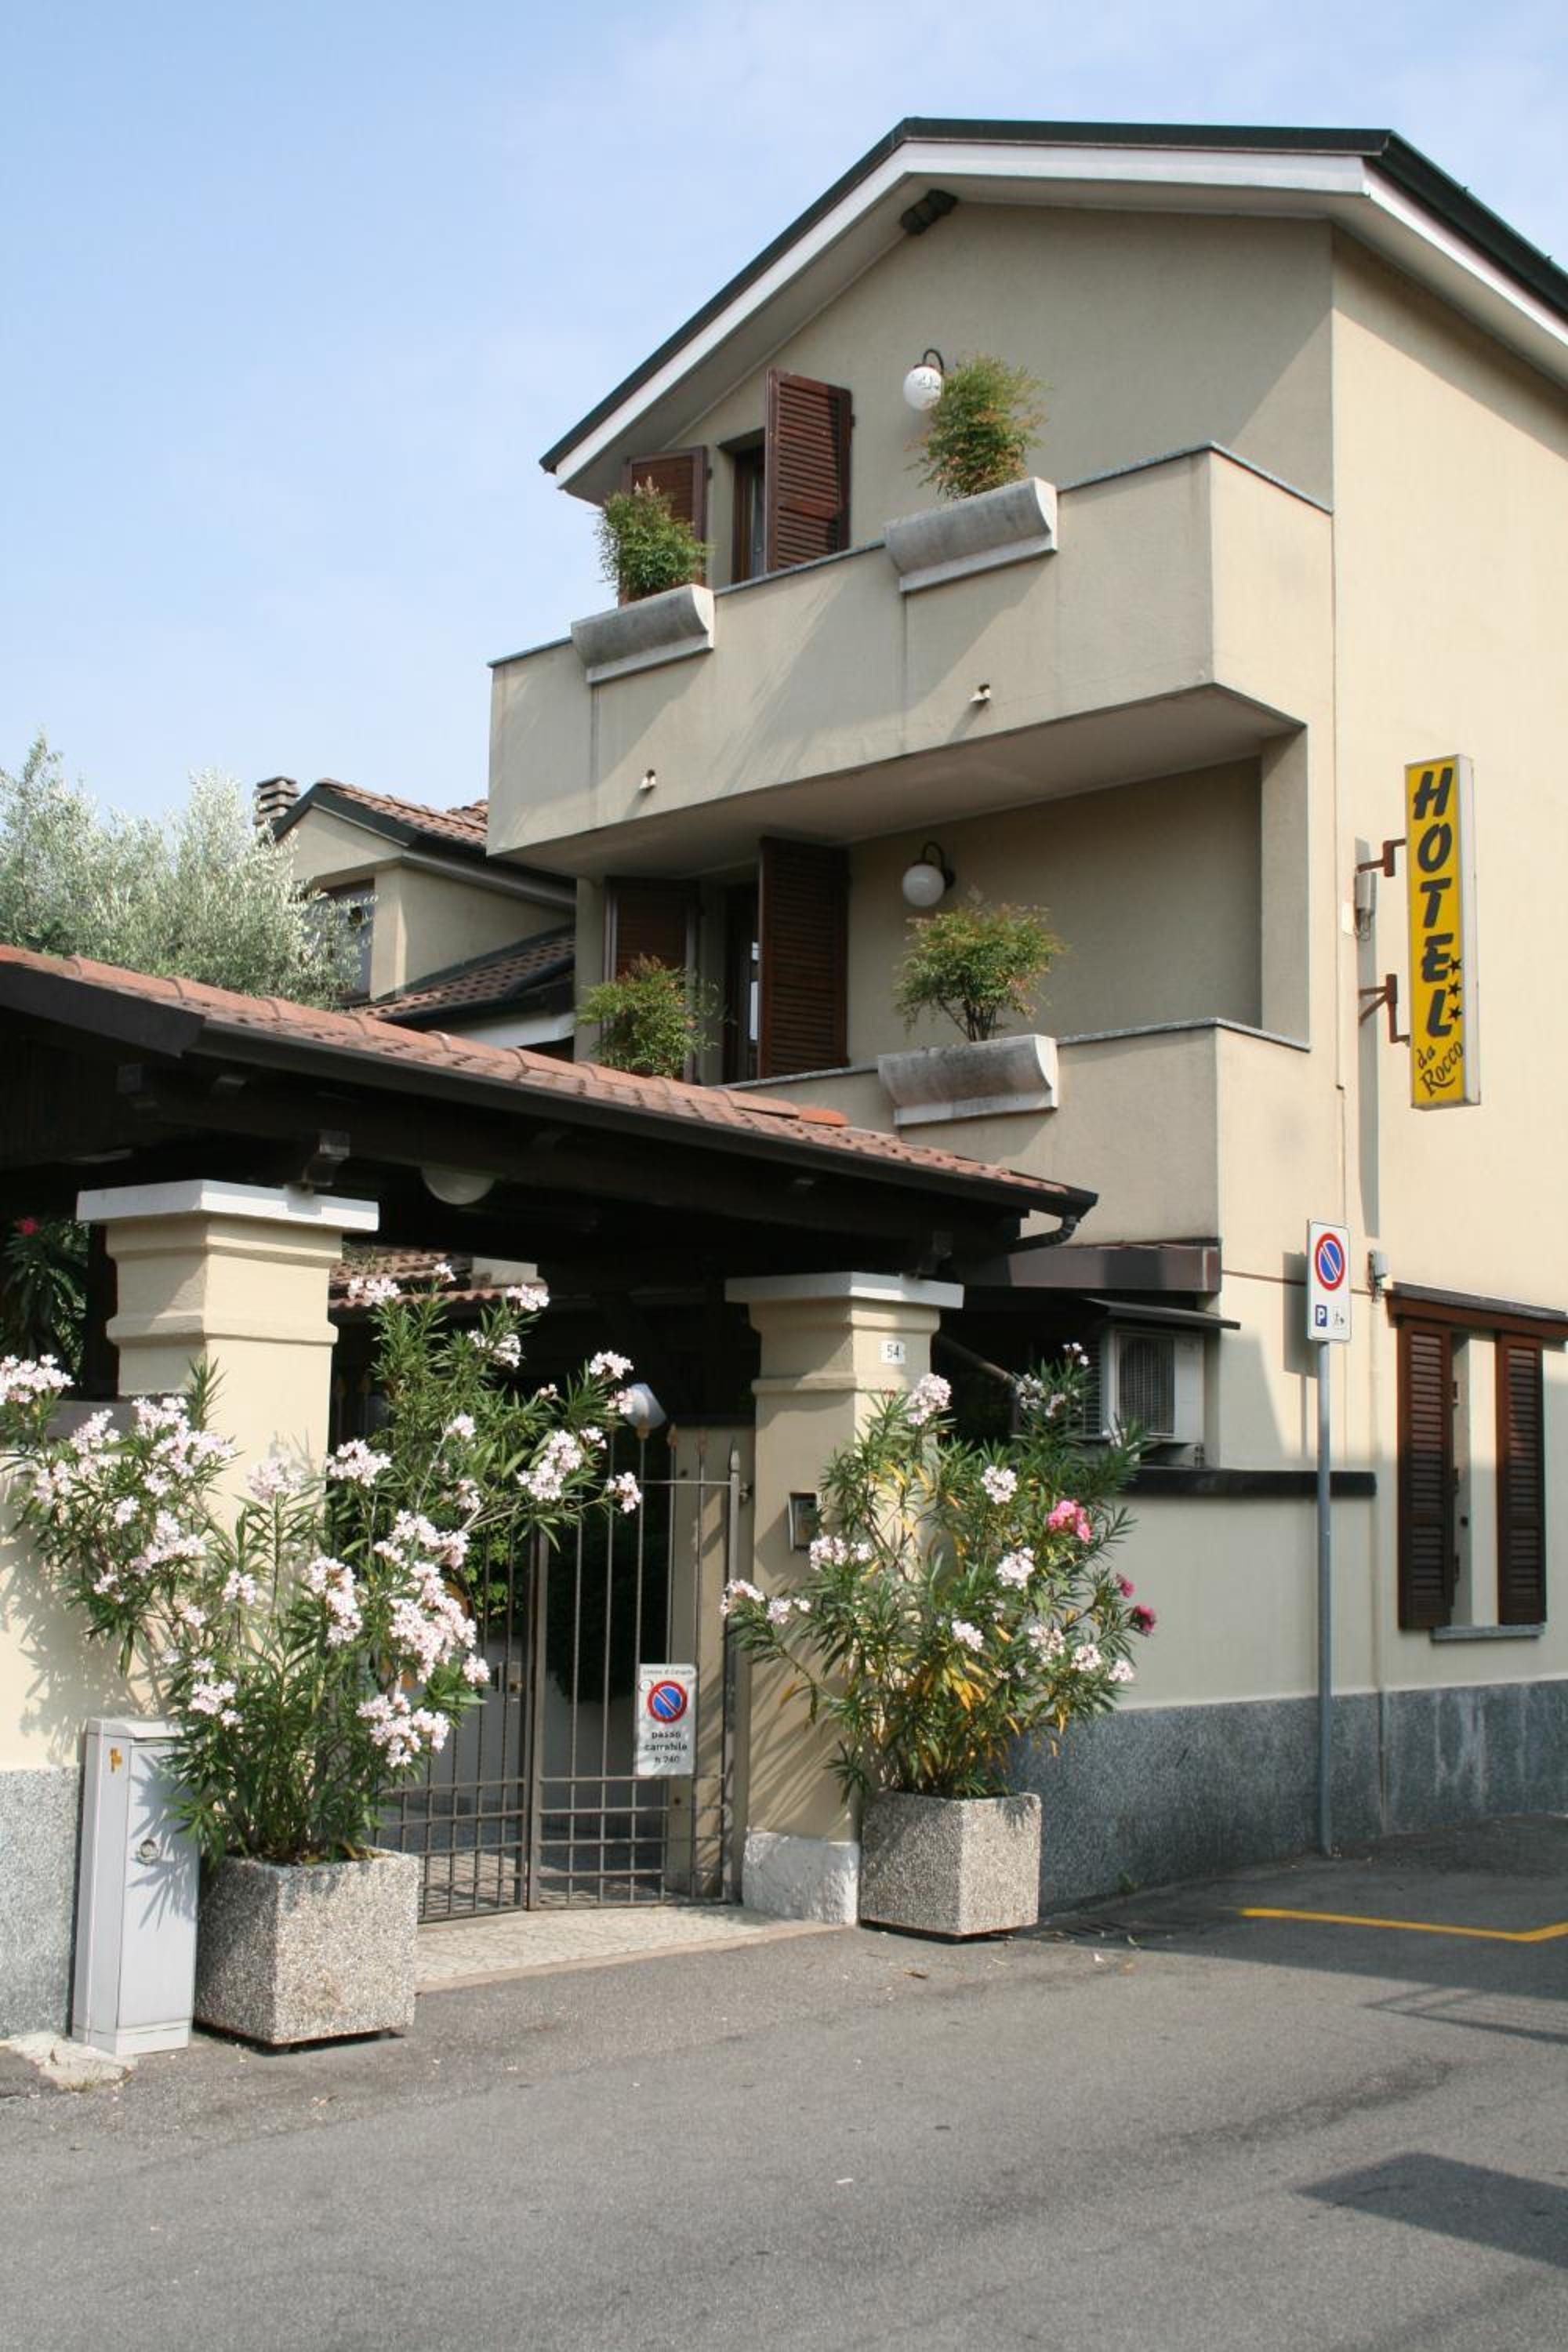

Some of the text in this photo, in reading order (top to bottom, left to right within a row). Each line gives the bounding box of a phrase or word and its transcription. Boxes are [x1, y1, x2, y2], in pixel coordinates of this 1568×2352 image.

[1413, 768, 1453, 1037] HOTEL
[1417, 1046, 1436, 1069] da
[887, 1345, 899, 1359] 54
